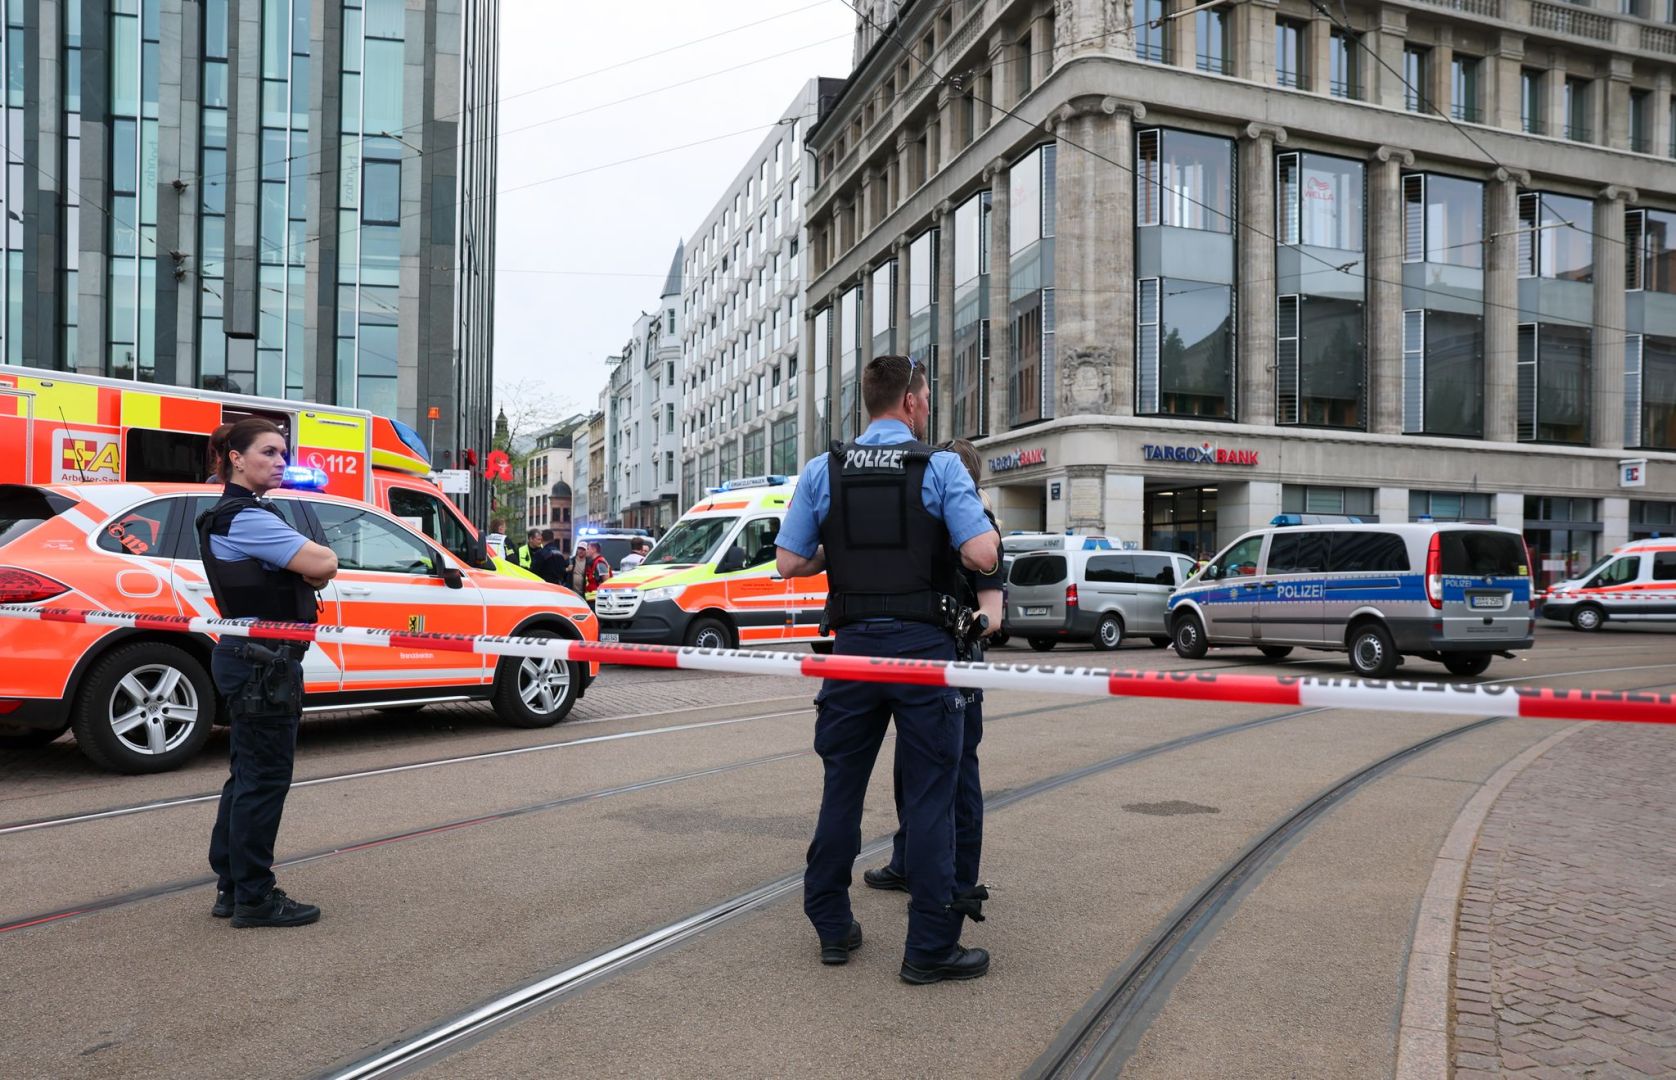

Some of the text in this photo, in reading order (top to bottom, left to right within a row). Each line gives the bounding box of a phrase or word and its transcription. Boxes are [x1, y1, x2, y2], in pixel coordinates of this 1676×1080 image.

[326, 454, 358, 475] 112
[844, 449, 908, 469] POLIZEI
[119, 534, 150, 556] 112
[1277, 585, 1324, 599] POLIZEI
[1445, 579, 1472, 588] POLIZEI
